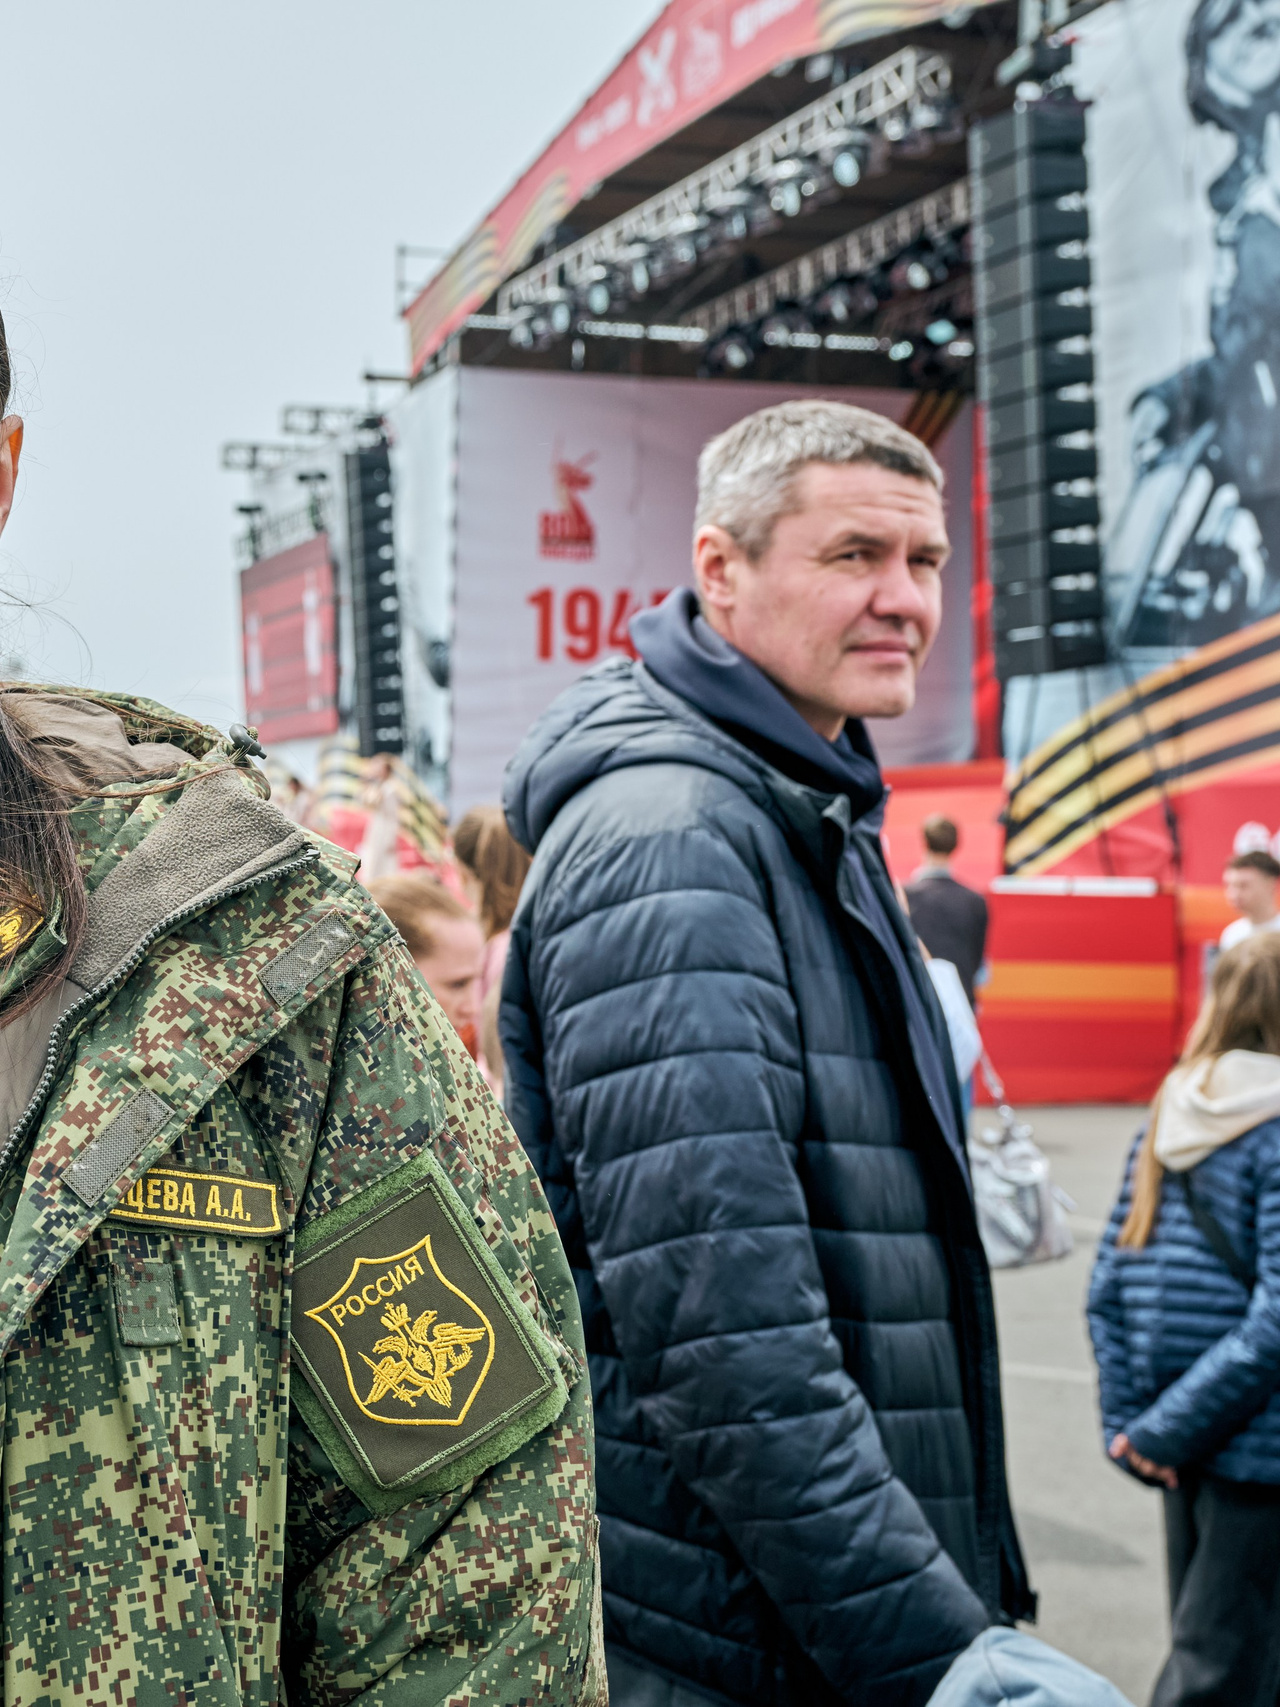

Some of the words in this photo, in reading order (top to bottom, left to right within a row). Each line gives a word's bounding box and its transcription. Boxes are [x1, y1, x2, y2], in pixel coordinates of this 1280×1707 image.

[527, 586, 672, 664] 194
[120, 1178, 195, 1217] ЦЕВА
[206, 1185, 251, 1222] А.А.
[329, 1254, 425, 1327] РОССИЯ
